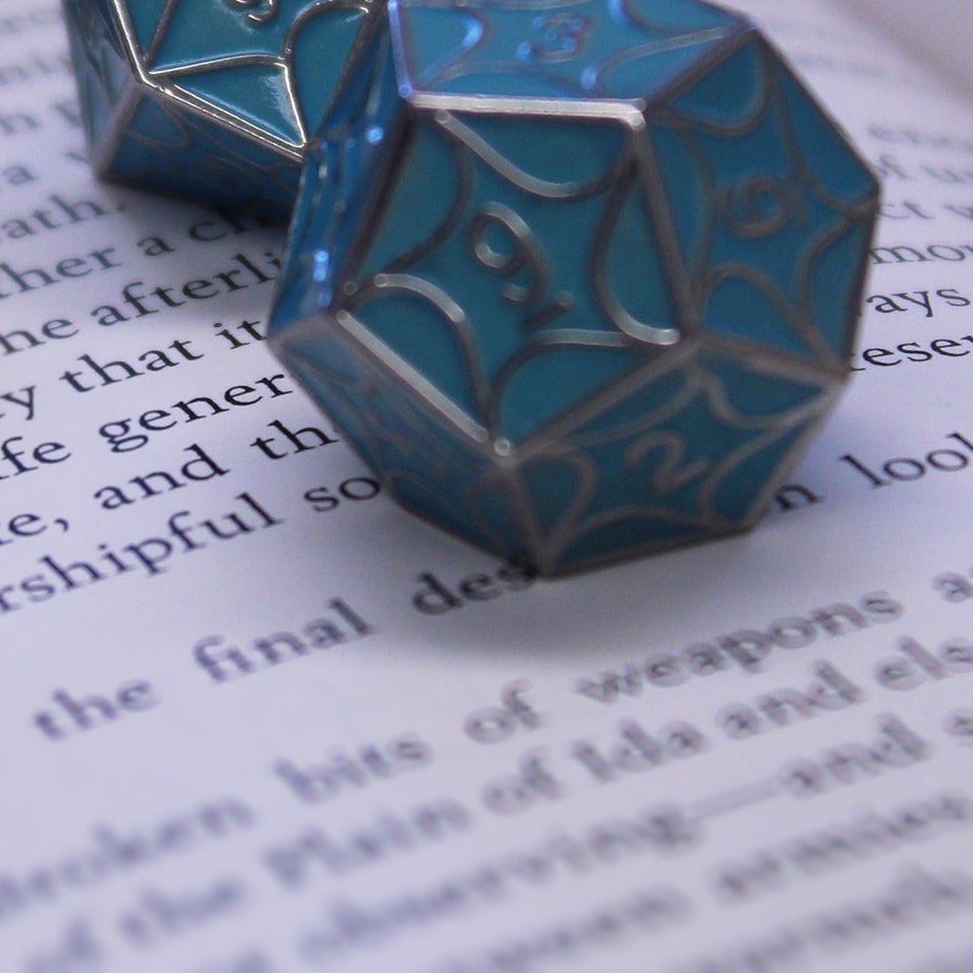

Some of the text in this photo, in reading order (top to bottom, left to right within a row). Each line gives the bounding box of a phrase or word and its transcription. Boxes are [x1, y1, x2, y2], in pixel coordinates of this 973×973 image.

[136, 236, 175, 257] a
[58, 336, 206, 395] that
[93, 443, 232, 511] and
[303, 475, 382, 513] so
[32, 680, 159, 740] the
[191, 596, 376, 684] final
[463, 678, 544, 744] of
[574, 590, 904, 706] weapons
[481, 744, 566, 815] of
[714, 661, 864, 742] and
